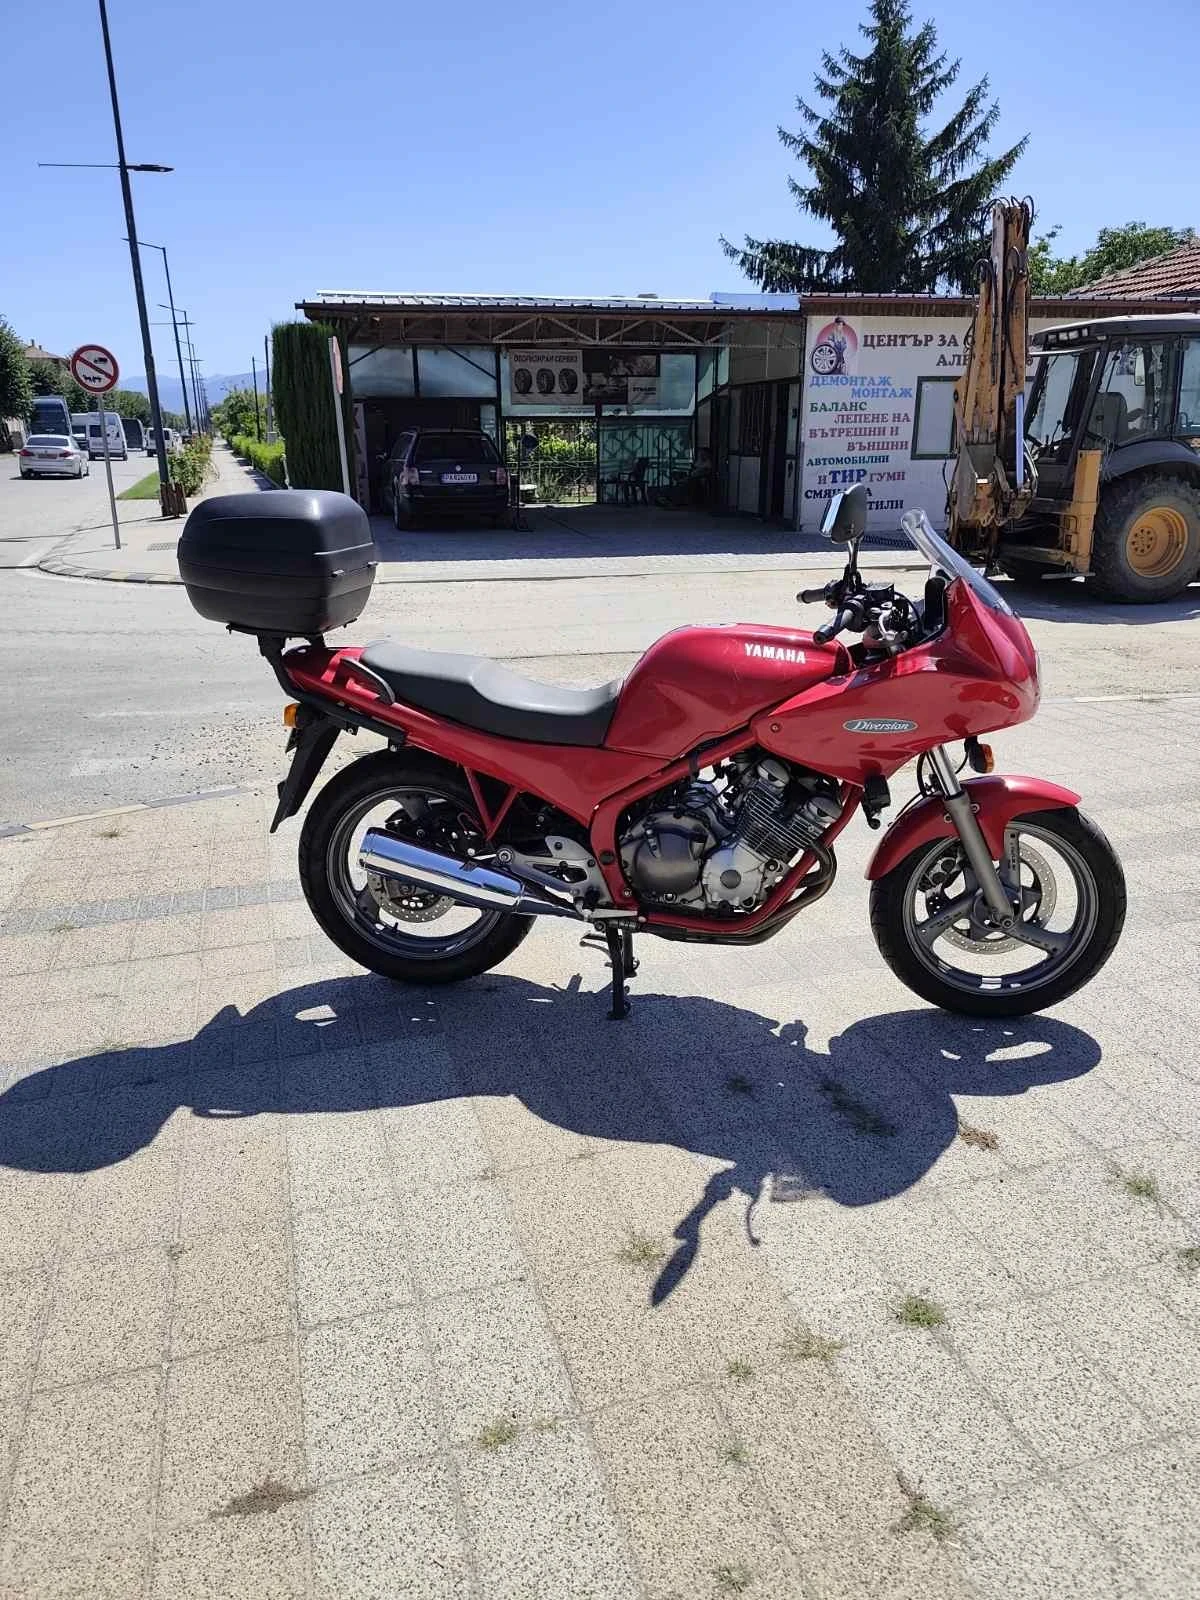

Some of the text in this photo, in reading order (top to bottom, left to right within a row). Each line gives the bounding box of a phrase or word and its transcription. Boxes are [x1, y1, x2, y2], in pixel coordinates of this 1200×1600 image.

[863, 334, 934, 349] ЦЕНТЪР
[937, 334, 959, 347] ЗА
[809, 376, 892, 387] ДЕМОНТАЖ
[851, 388, 913, 398] МОНТАЖ
[809, 401, 867, 412] БАЛАНС
[834, 413, 911, 424] ЛЕПЕНЕ НА
[809, 426, 899, 438] ВЪТРЕШНИ И
[847, 441, 909, 451] ВЪНШНИ
[806, 455, 890, 466] АВТОМОБИЛНИ
[817, 469, 906, 485] И ТИР ГУМИ
[744, 643, 807, 664] YAMAHA
[852, 719, 910, 731] Diversion
